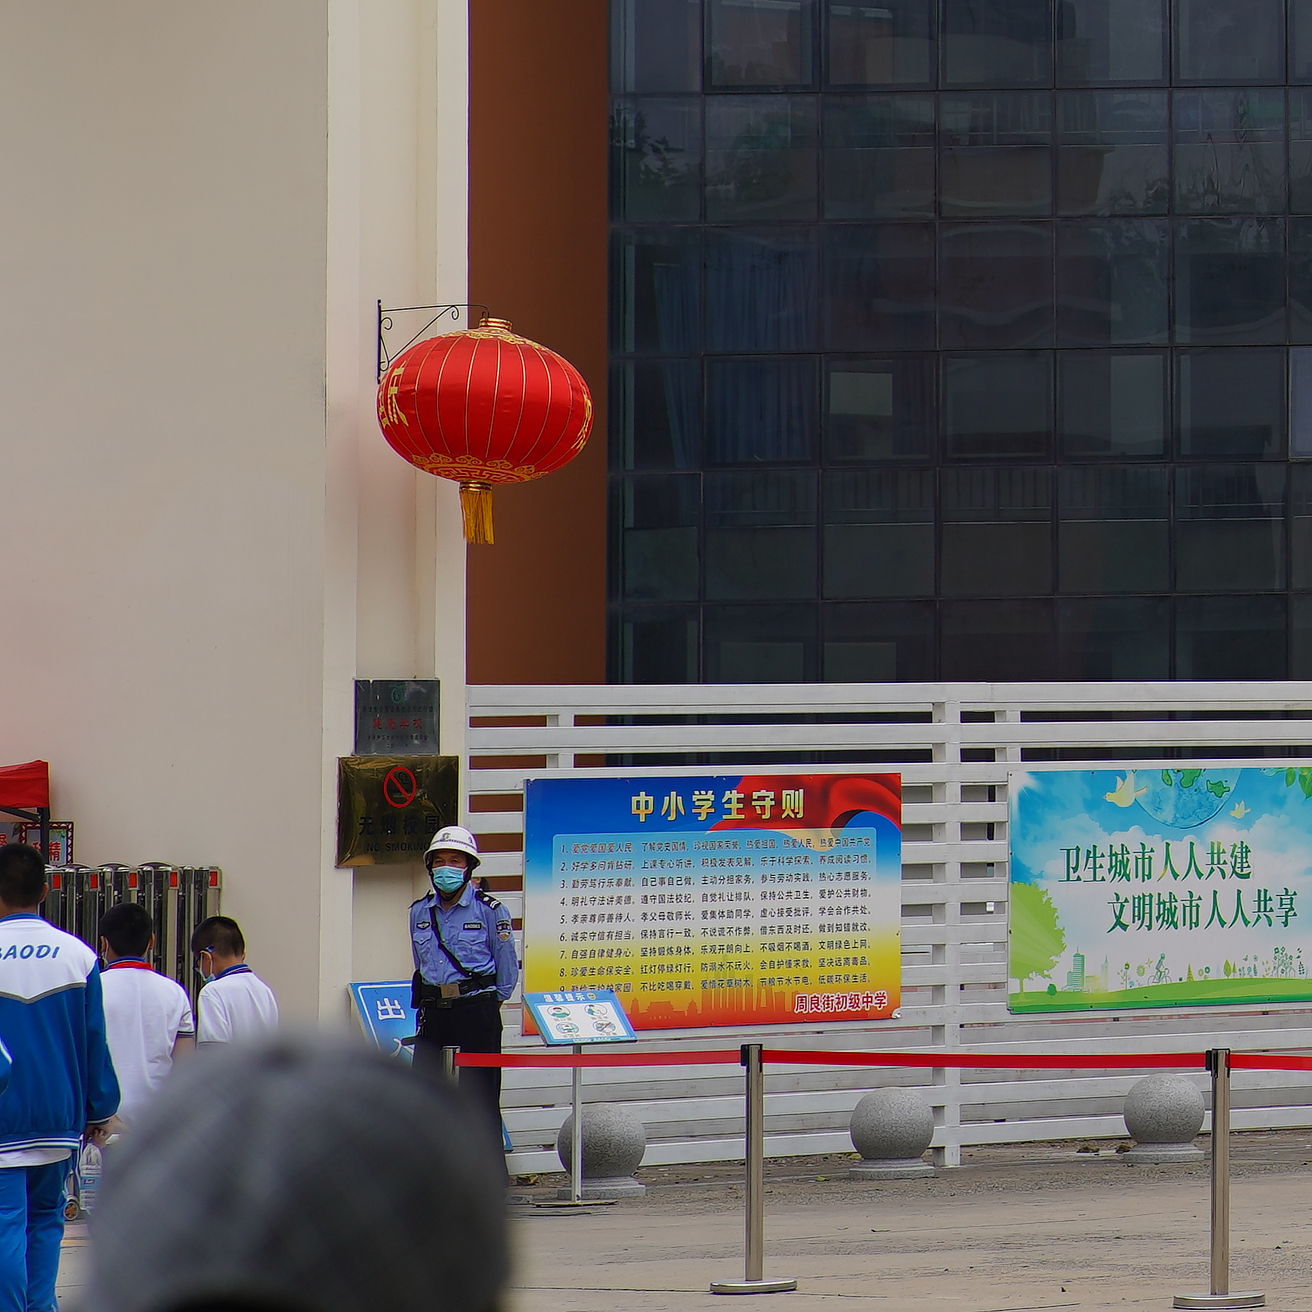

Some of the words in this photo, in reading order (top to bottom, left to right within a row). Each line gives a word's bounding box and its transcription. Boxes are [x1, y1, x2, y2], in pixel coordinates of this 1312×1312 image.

[631, 788, 805, 822] 中小学生守则
[359, 815, 440, 837] 无烟校园
[366, 842, 380, 852] NO
[1058, 840, 1252, 883] 卫生城市人人共建
[1106, 887, 1298, 934] 文明城市人人共享
[0, 945, 60, 960] AODI
[794, 991, 888, 1013] 周良街初级中学
